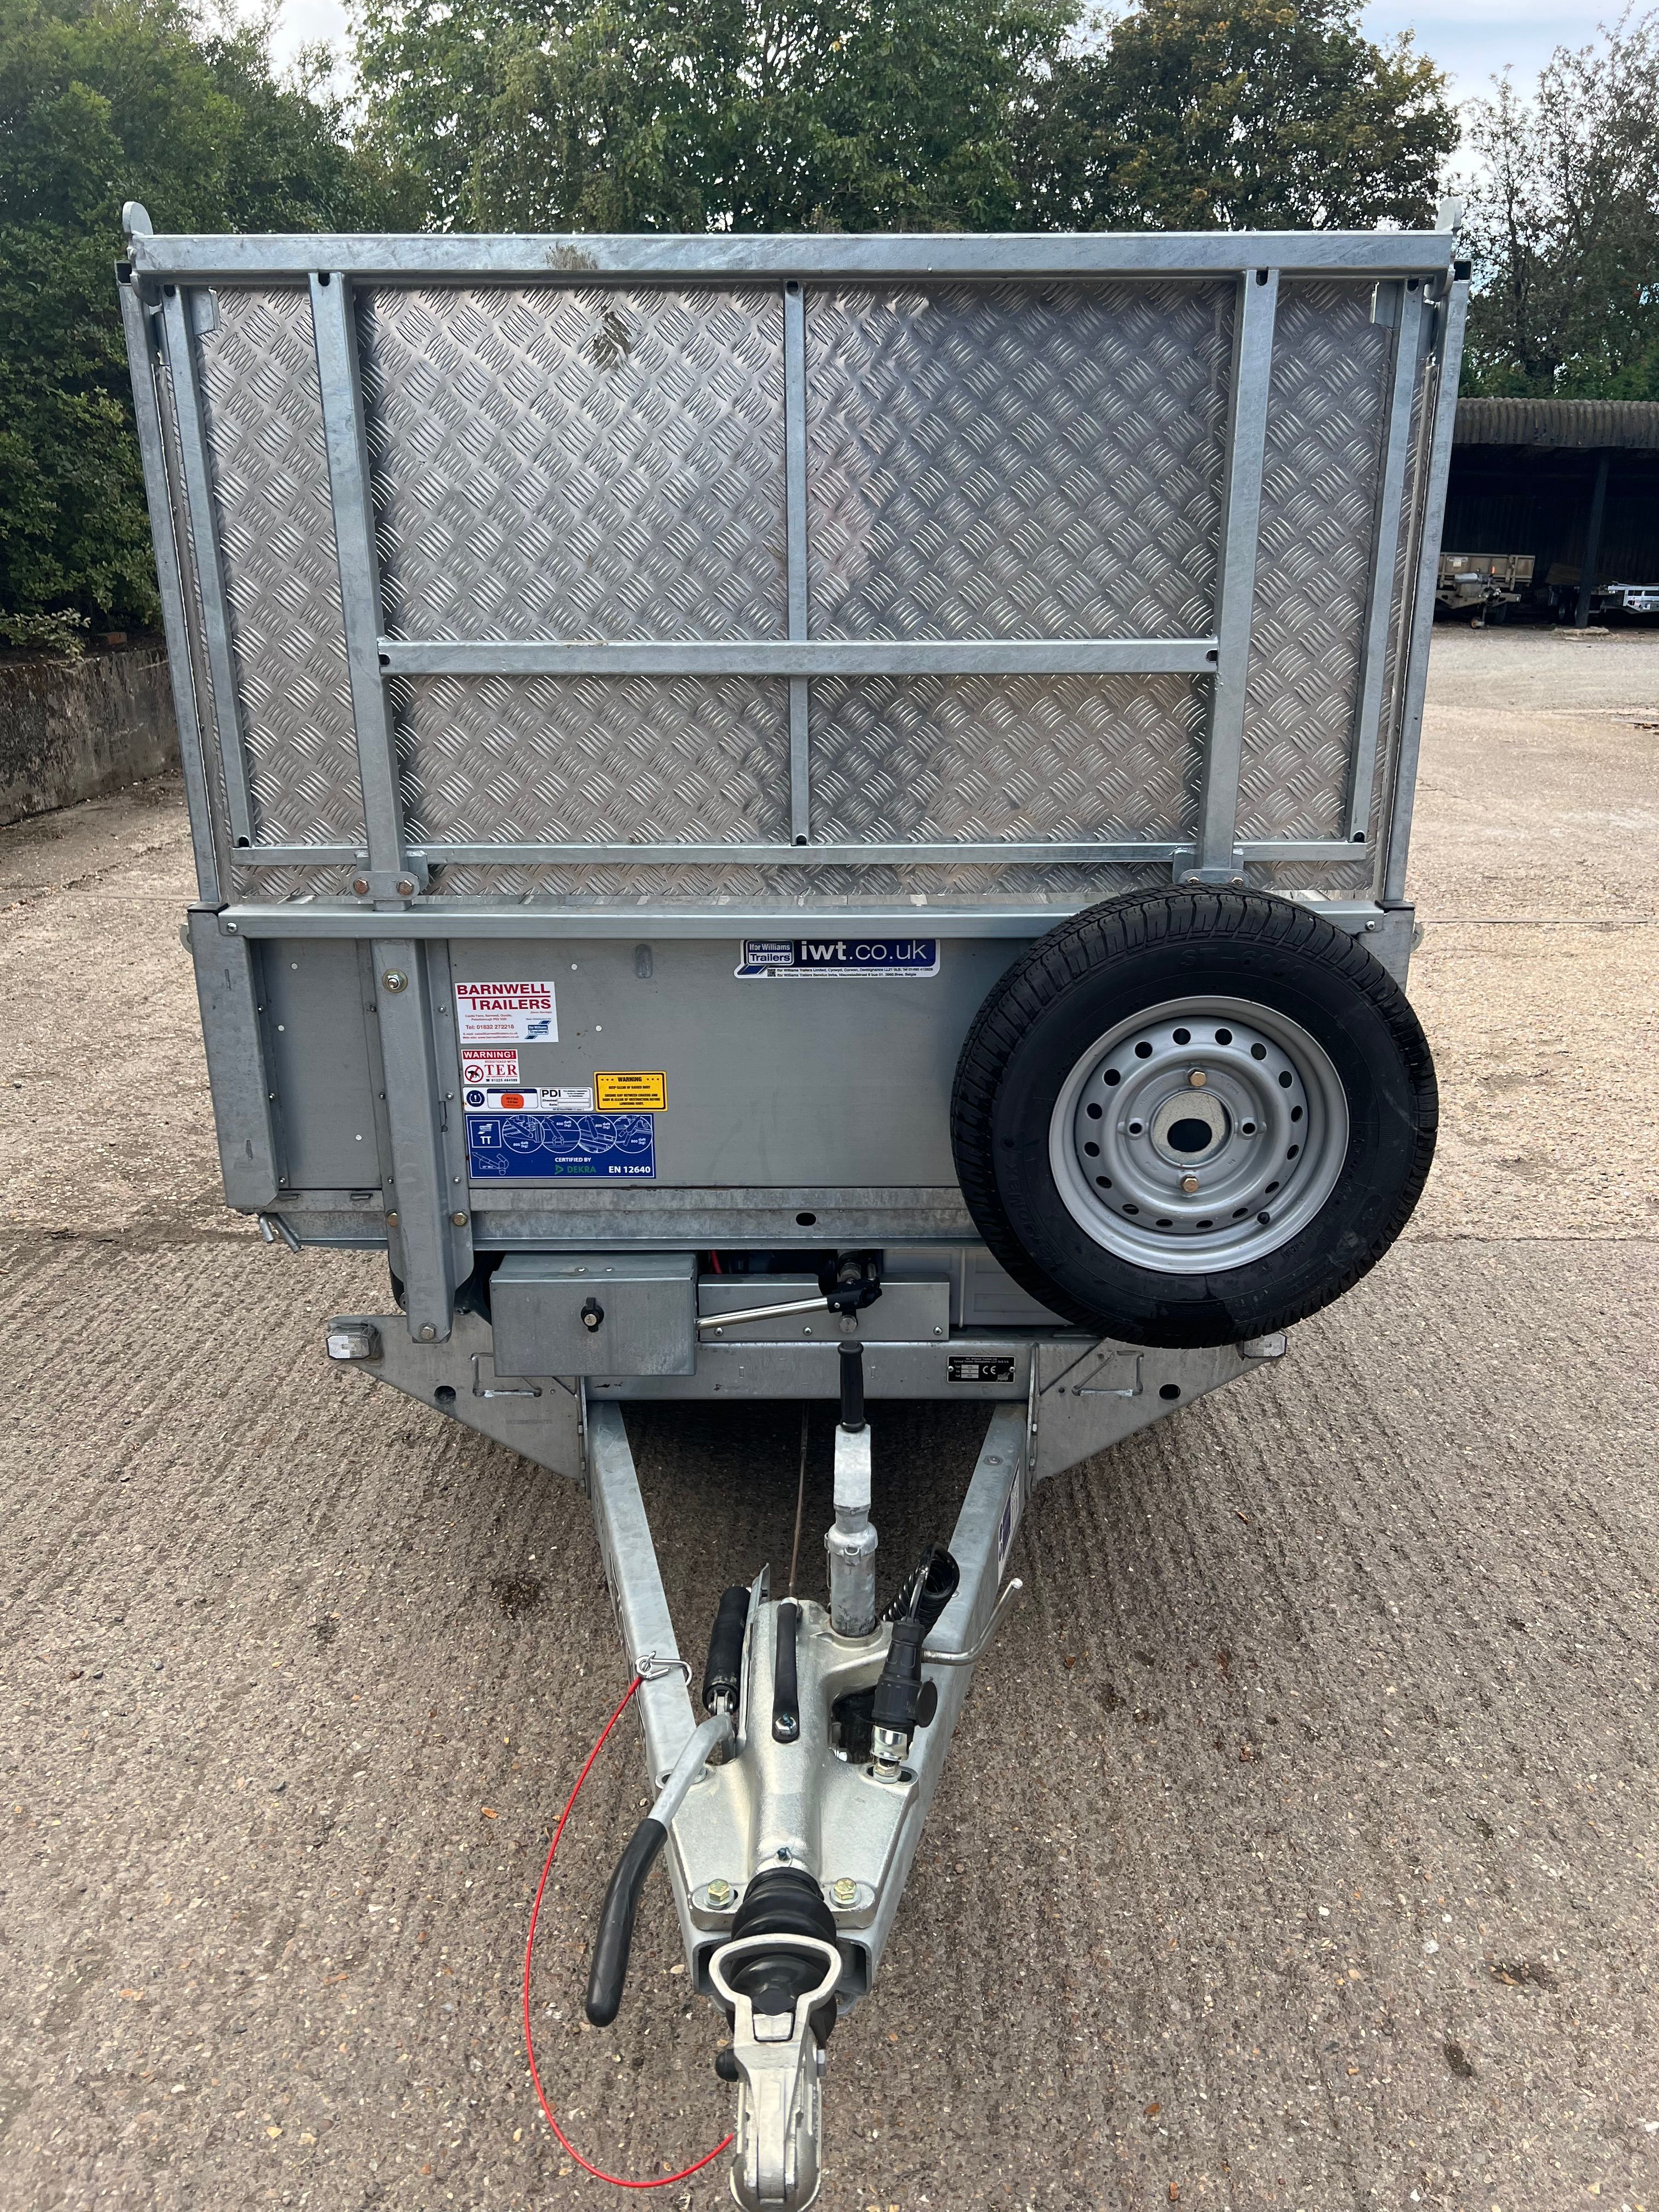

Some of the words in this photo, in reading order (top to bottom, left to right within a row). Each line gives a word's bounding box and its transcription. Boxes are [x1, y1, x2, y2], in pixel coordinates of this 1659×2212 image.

[801, 940, 927, 960] iwt.co.uk
[457, 984, 550, 995] BARNWELL
[471, 998, 551, 1010] TRAILERS
[484, 1064, 518, 1075] TER
[480, 1136, 492, 1144] TT
